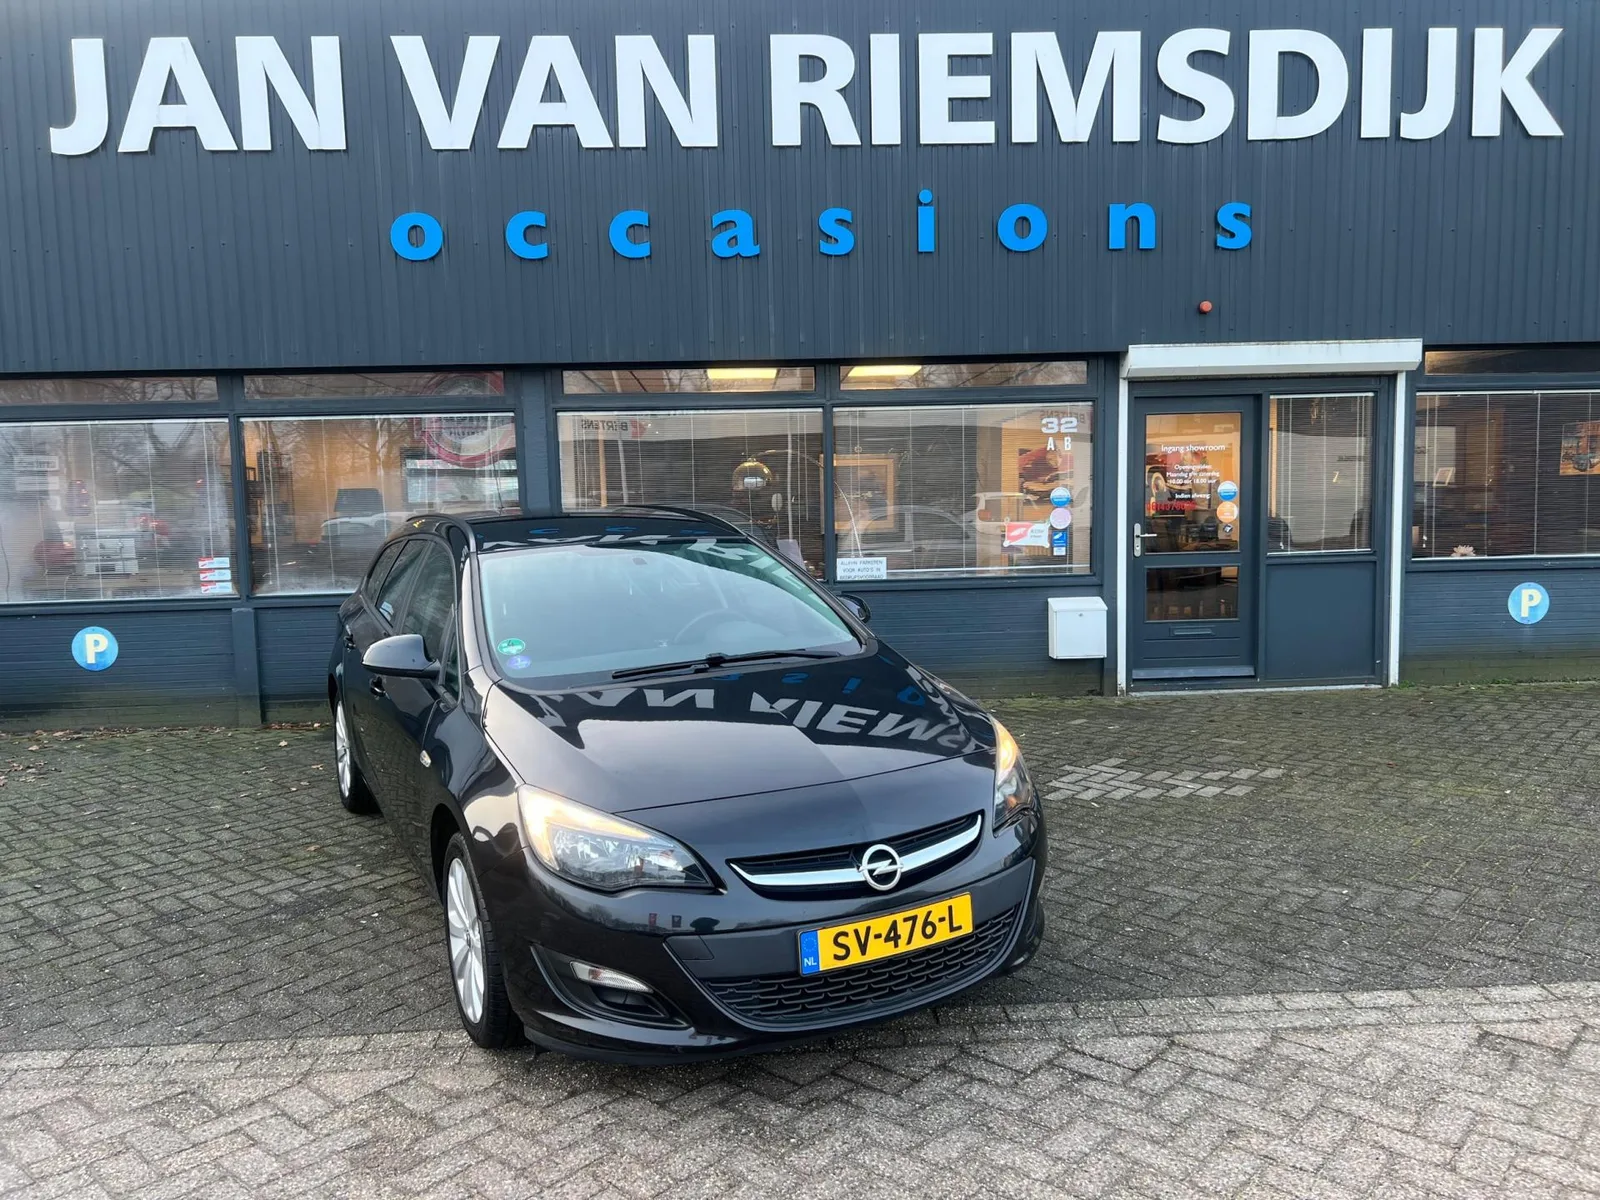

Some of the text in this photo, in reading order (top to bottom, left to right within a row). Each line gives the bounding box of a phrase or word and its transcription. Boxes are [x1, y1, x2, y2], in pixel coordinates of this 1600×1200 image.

[50, 28, 1564, 155] JAN VAN RIEMSDIJK
[390, 189, 1253, 261] occasions
[1041, 416, 1078, 433] 32
[1046, 436, 1072, 451] A B
[1161, 443, 1226, 453] Ingang showroom
[1521, 589, 1542, 618] P
[85, 633, 108, 664] P
[833, 905, 963, 961] SV-476-L
[804, 957, 818, 967] NL
